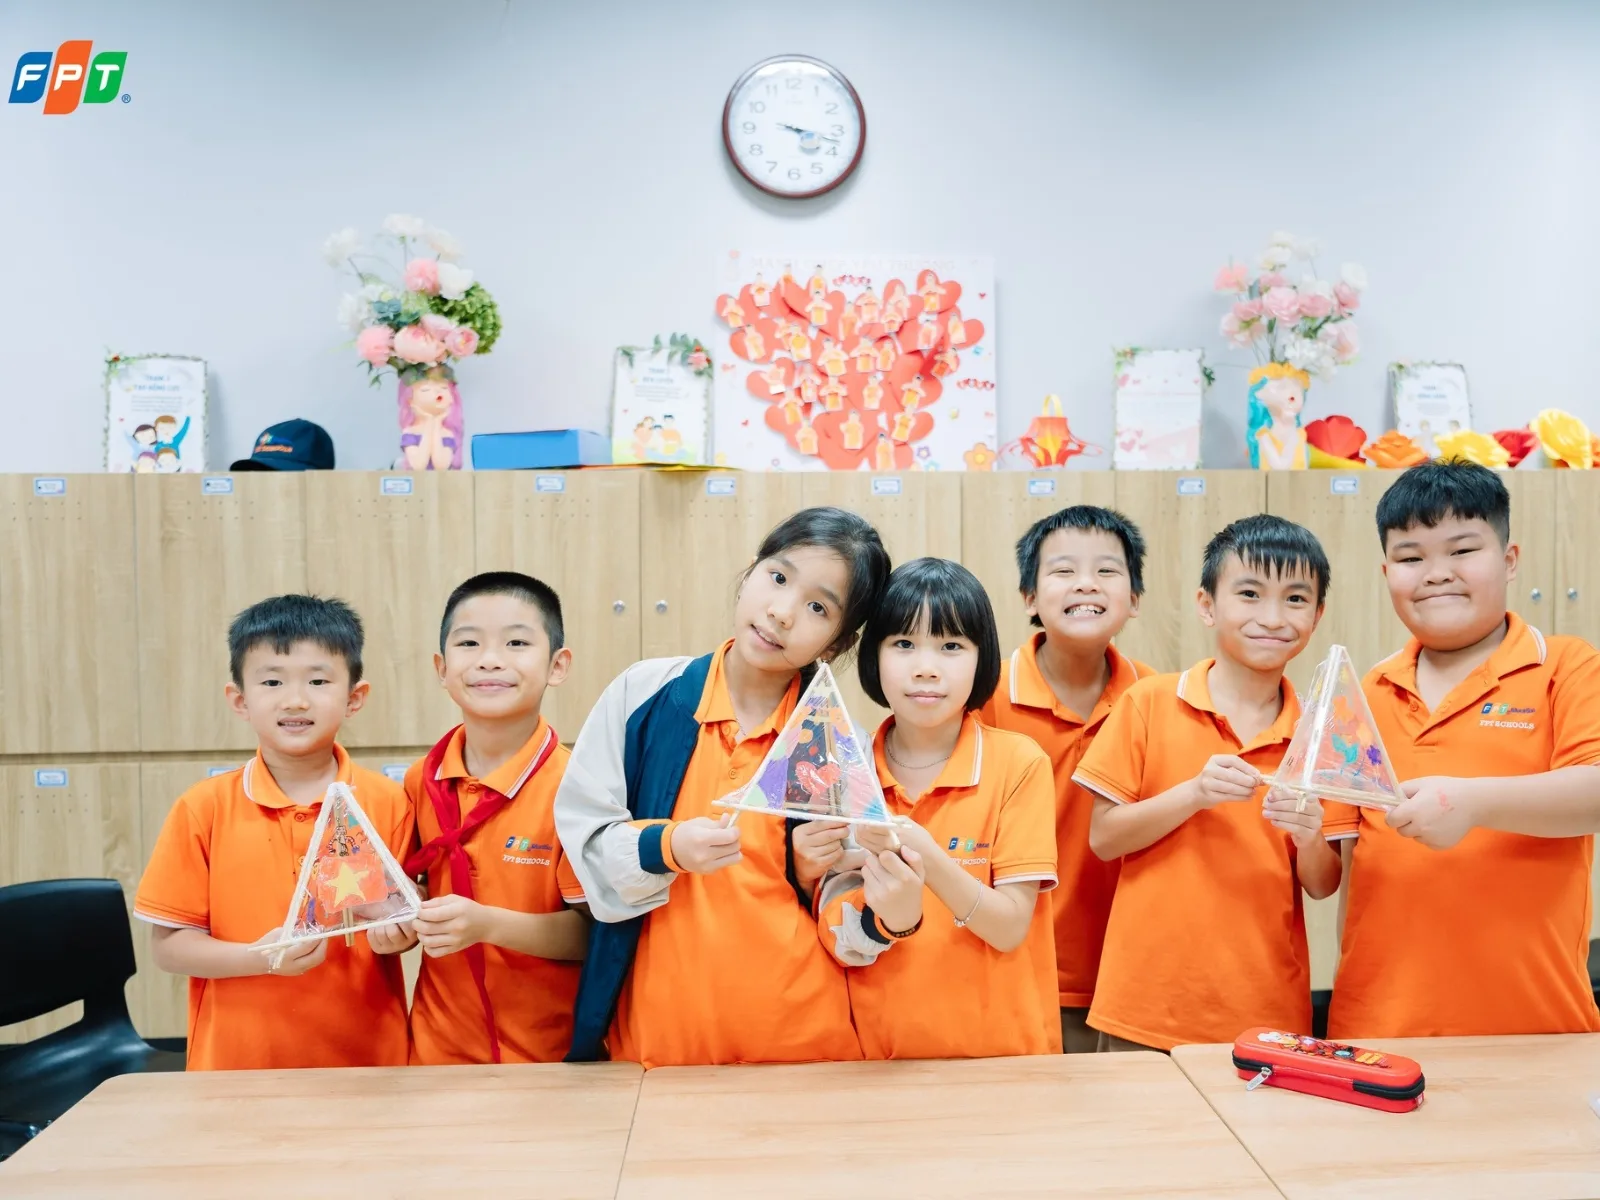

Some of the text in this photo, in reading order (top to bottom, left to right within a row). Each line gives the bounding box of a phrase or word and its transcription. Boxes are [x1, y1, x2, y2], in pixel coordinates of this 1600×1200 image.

[785, 77, 803, 90] 12
[765, 84, 778, 97] 11
[814, 85, 820, 97] 1
[748, 101, 766, 114] 10
[824, 102, 840, 115] 2
[742, 120, 757, 135] 9
[831, 124, 845, 137] 3
[748, 143, 764, 156] 8
[824, 146, 839, 158] 4
[765, 160, 779, 173] 7
[809, 162, 824, 175] 5
[787, 168, 801, 181] 6
[1480, 719, 1535, 730] FPT SCHOOLS
[515, 856, 551, 866] SCHOOLS
